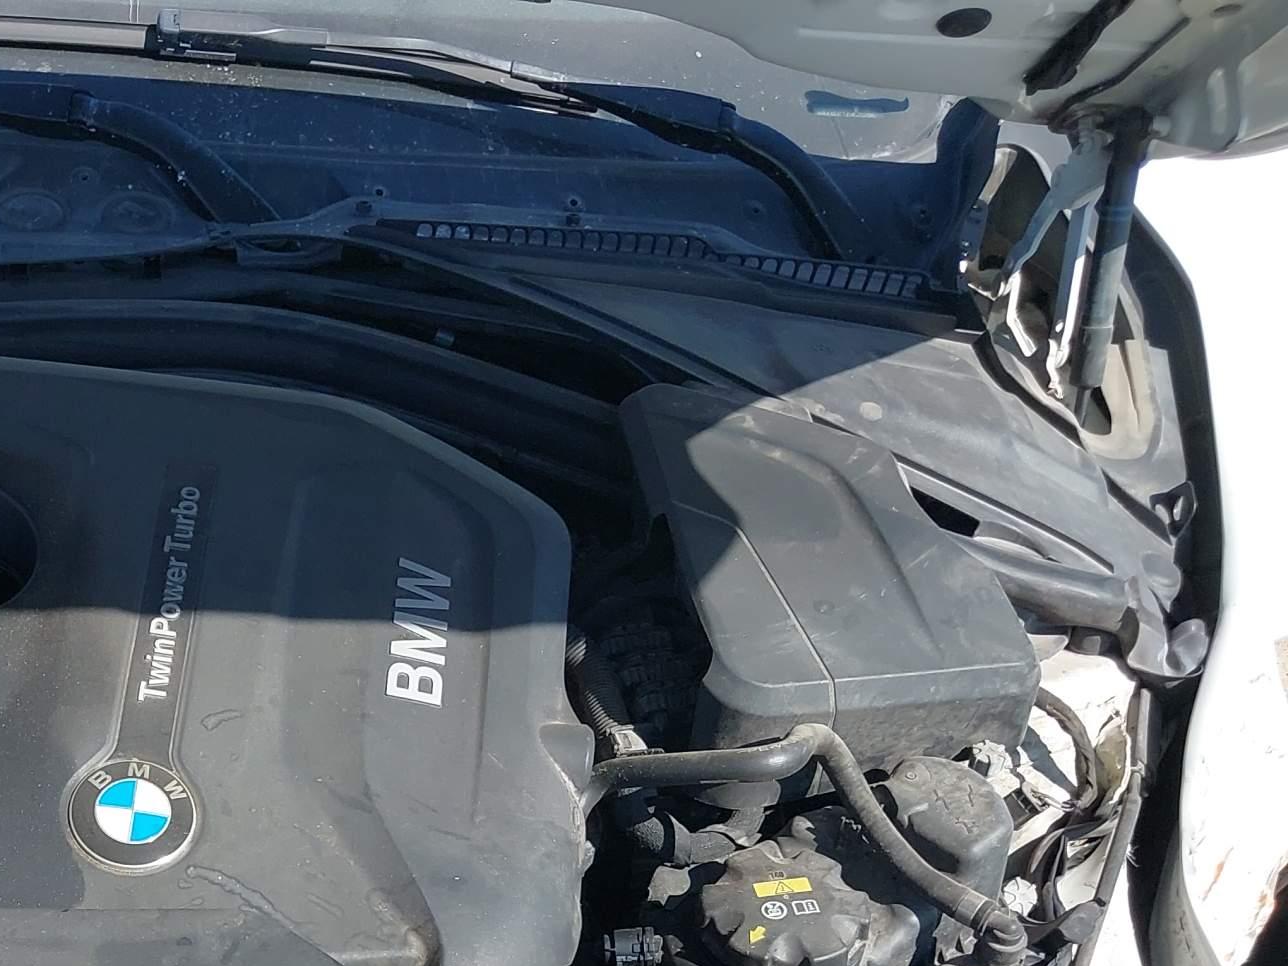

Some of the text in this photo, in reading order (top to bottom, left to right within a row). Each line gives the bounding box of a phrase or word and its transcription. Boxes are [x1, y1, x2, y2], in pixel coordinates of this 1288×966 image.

[137, 485, 201, 702] TwinPower Turbo
[383, 556, 452, 708] BMW
[86, 762, 188, 802] BMW
